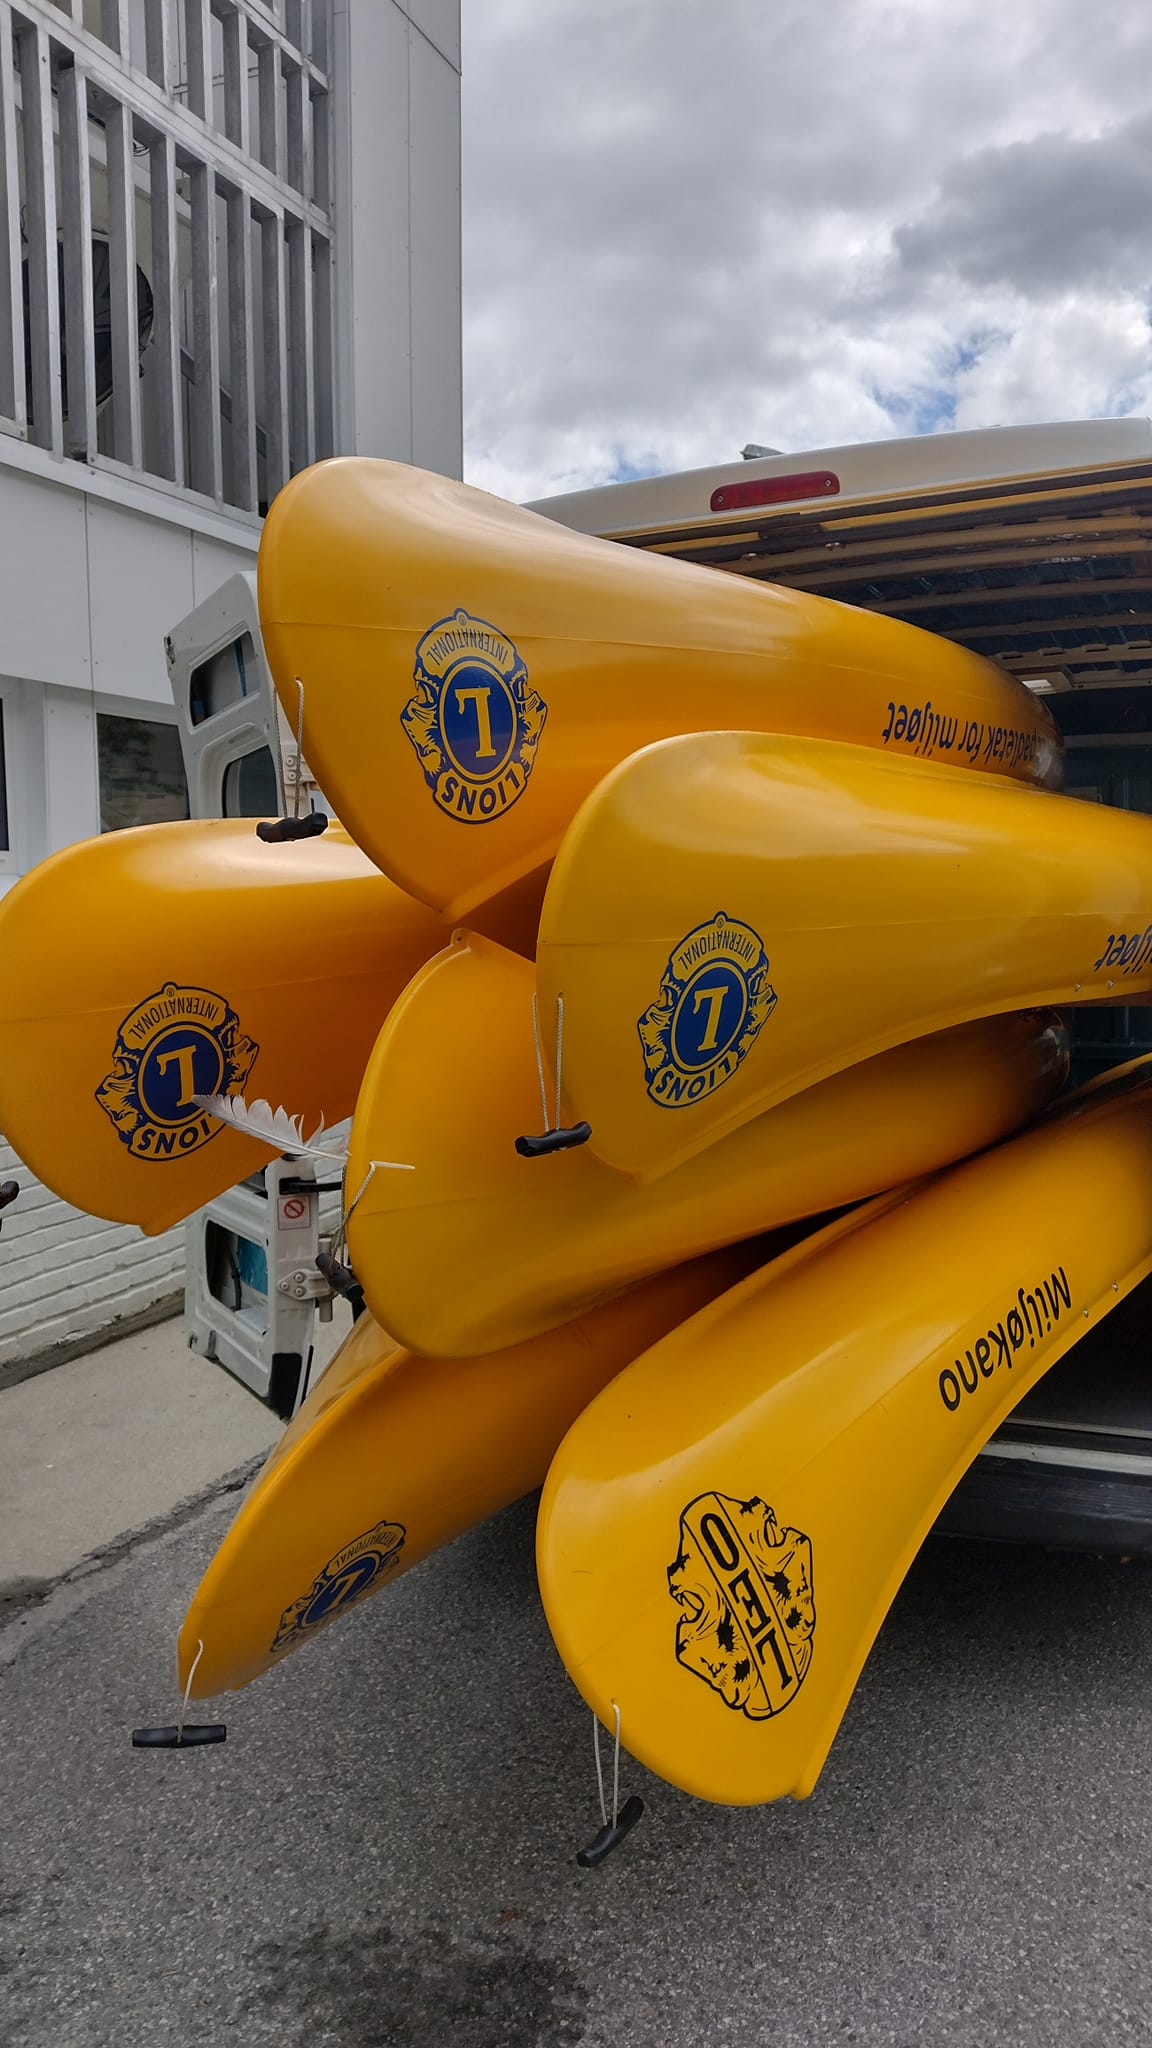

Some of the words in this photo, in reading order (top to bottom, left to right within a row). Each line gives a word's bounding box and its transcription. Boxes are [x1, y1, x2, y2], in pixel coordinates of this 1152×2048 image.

[426, 628, 509, 666] INTERNATIONAL
[454, 687, 497, 758] L
[881, 701, 958, 758] miljøet
[957, 720, 985, 763] for
[440, 772, 521, 816] LIONS
[677, 930, 757, 970] INTERNATIONAL
[1093, 924, 1152, 975] iljøet
[127, 997, 220, 1040] INTERNATIONAL
[693, 985, 729, 1052] L
[654, 1058, 732, 1102] LIONS
[136, 1112, 213, 1154] IONS
[938, 1266, 1072, 1412] Miljøkano
[699, 1512, 793, 1690] LEO
